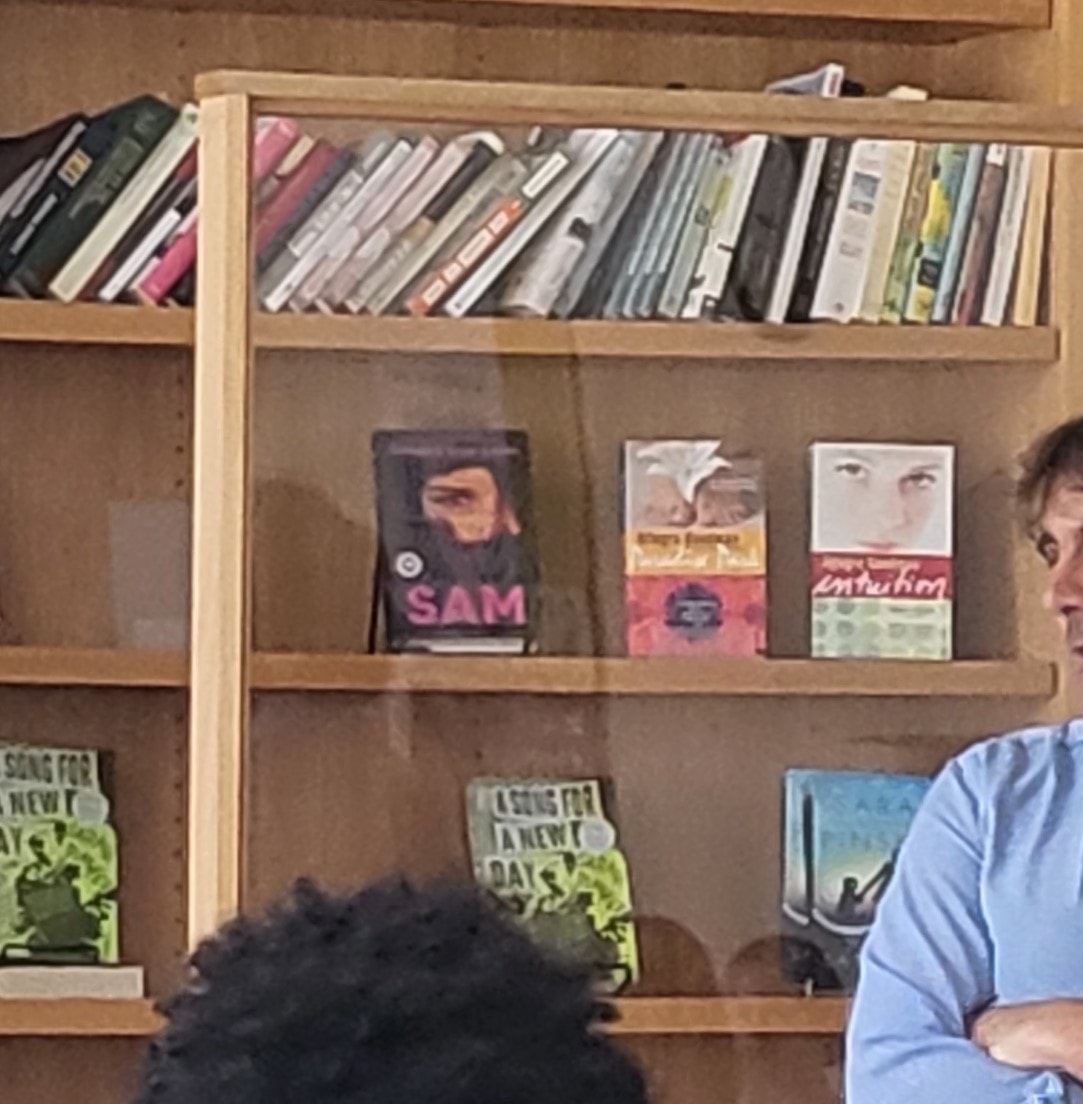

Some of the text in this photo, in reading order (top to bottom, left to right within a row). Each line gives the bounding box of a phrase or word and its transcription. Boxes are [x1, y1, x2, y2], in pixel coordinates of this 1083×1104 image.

[406, 583, 527, 626] SAM
[5, 751, 92, 788] SONG FOR
[9, 790, 59, 816] NEW
[509, 787, 559, 816] SONG
[561, 784, 597, 818] FOR
[0, 826, 22, 857] AY
[501, 826, 516, 850] A
[519, 823, 566, 850] NEW
[489, 859, 535, 889] DAY
